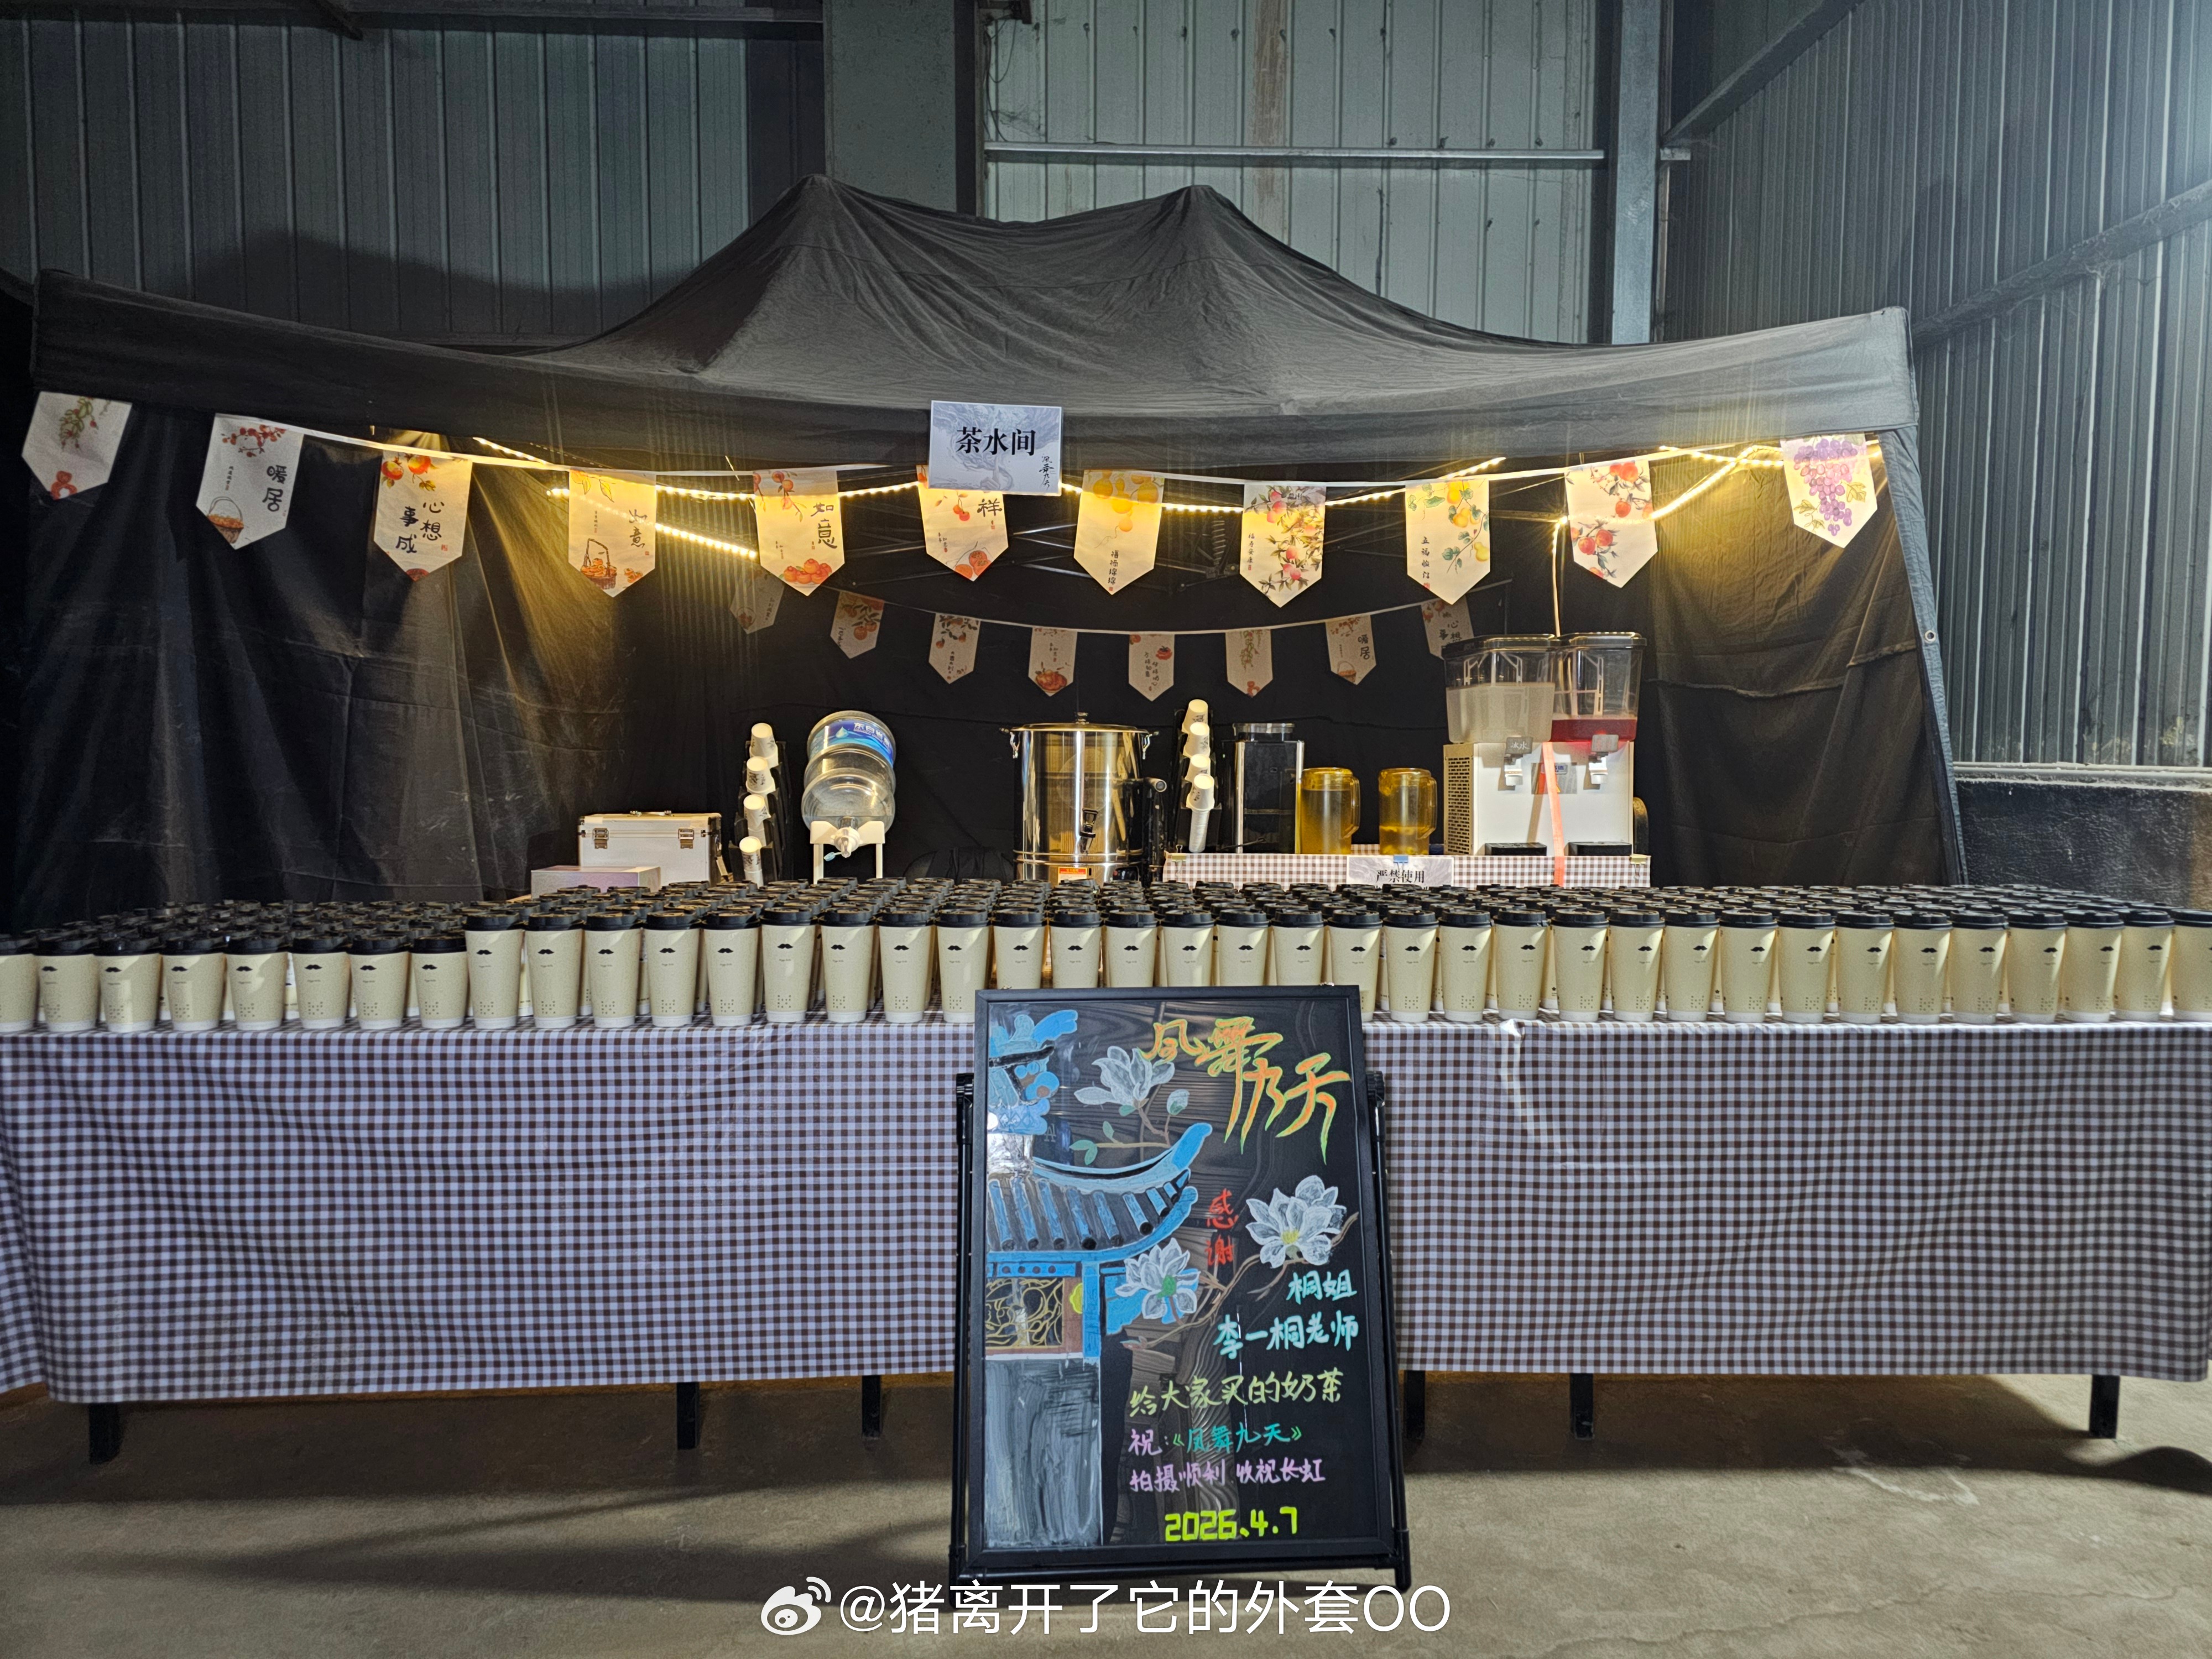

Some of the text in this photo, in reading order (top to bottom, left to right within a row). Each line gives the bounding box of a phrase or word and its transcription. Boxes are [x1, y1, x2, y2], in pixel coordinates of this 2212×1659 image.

[956, 426, 1036, 456] 茶水间
[262, 465, 287, 512] 暖居
[977, 491, 1002, 517] 祥
[395, 506, 419, 554] 事成
[420, 502, 445, 541] 心想
[811, 502, 837, 549] 如意
[1421, 536, 1430, 579] 五福临门
[1358, 634, 1370, 660] 暖居
[1376, 869, 1425, 883] 严禁使用
[1204, 1188, 1239, 1266] 感谢
[1286, 1270, 1357, 1305] 桐姐
[1214, 1310, 1359, 1359] 李一桐老师
[1129, 1367, 1343, 1417] 给大家买的奶茶
[1130, 1457, 1326, 1493] 拍摄顺利 收视长虹
